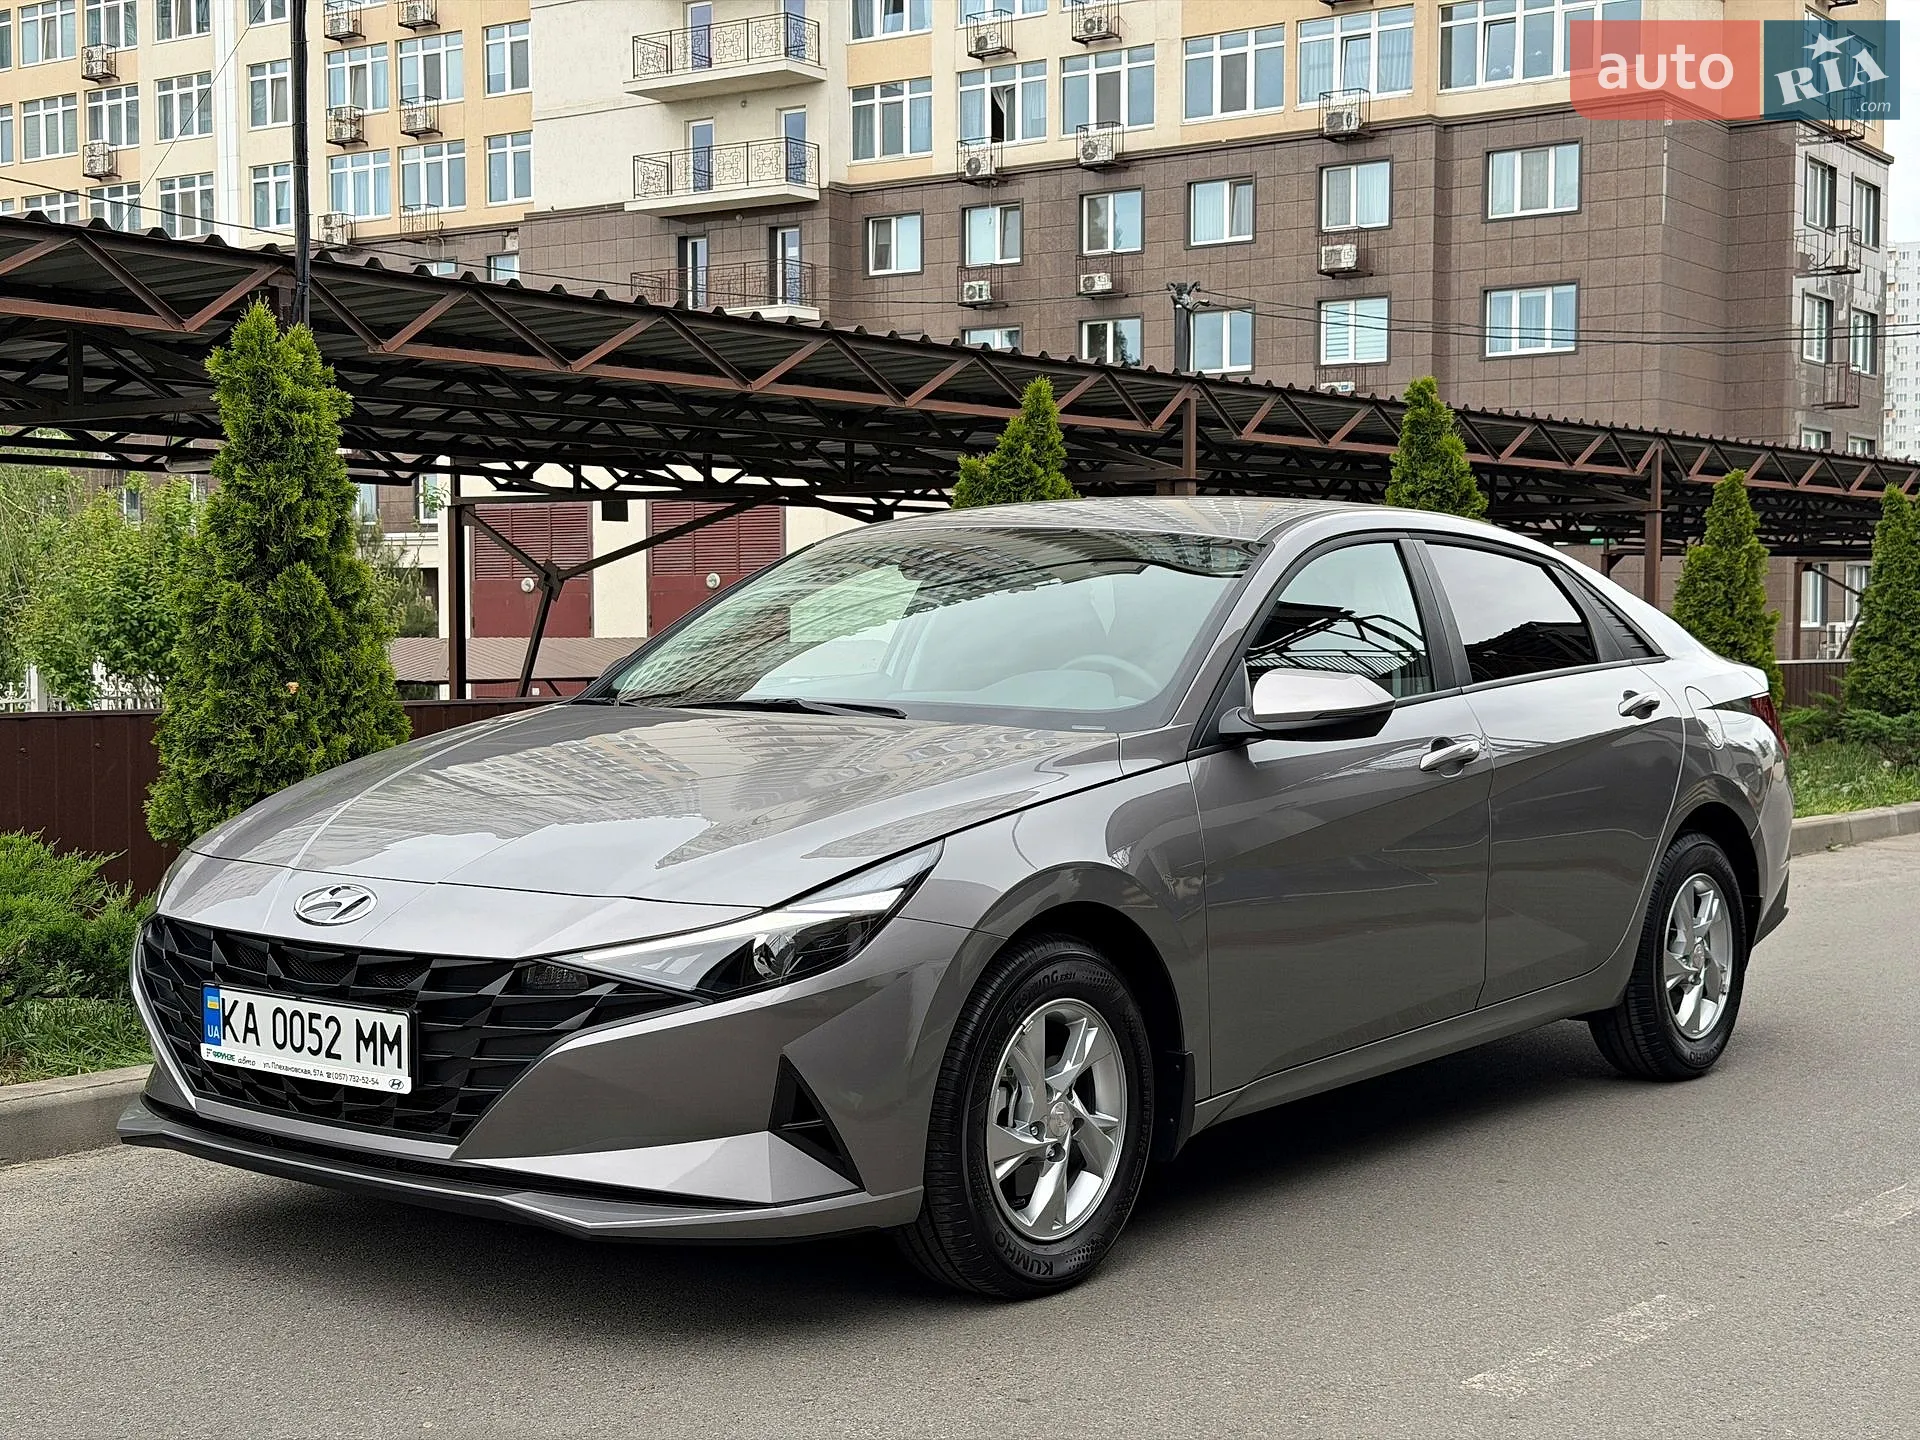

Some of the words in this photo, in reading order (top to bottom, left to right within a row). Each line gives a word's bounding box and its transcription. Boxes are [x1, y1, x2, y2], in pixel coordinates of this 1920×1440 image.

[207, 1024, 220, 1039] UA
[221, 997, 261, 1047] KA
[272, 1006, 342, 1061] 0052
[355, 1018, 402, 1069] MM
[994, 1230, 1053, 1276] KUMHO
